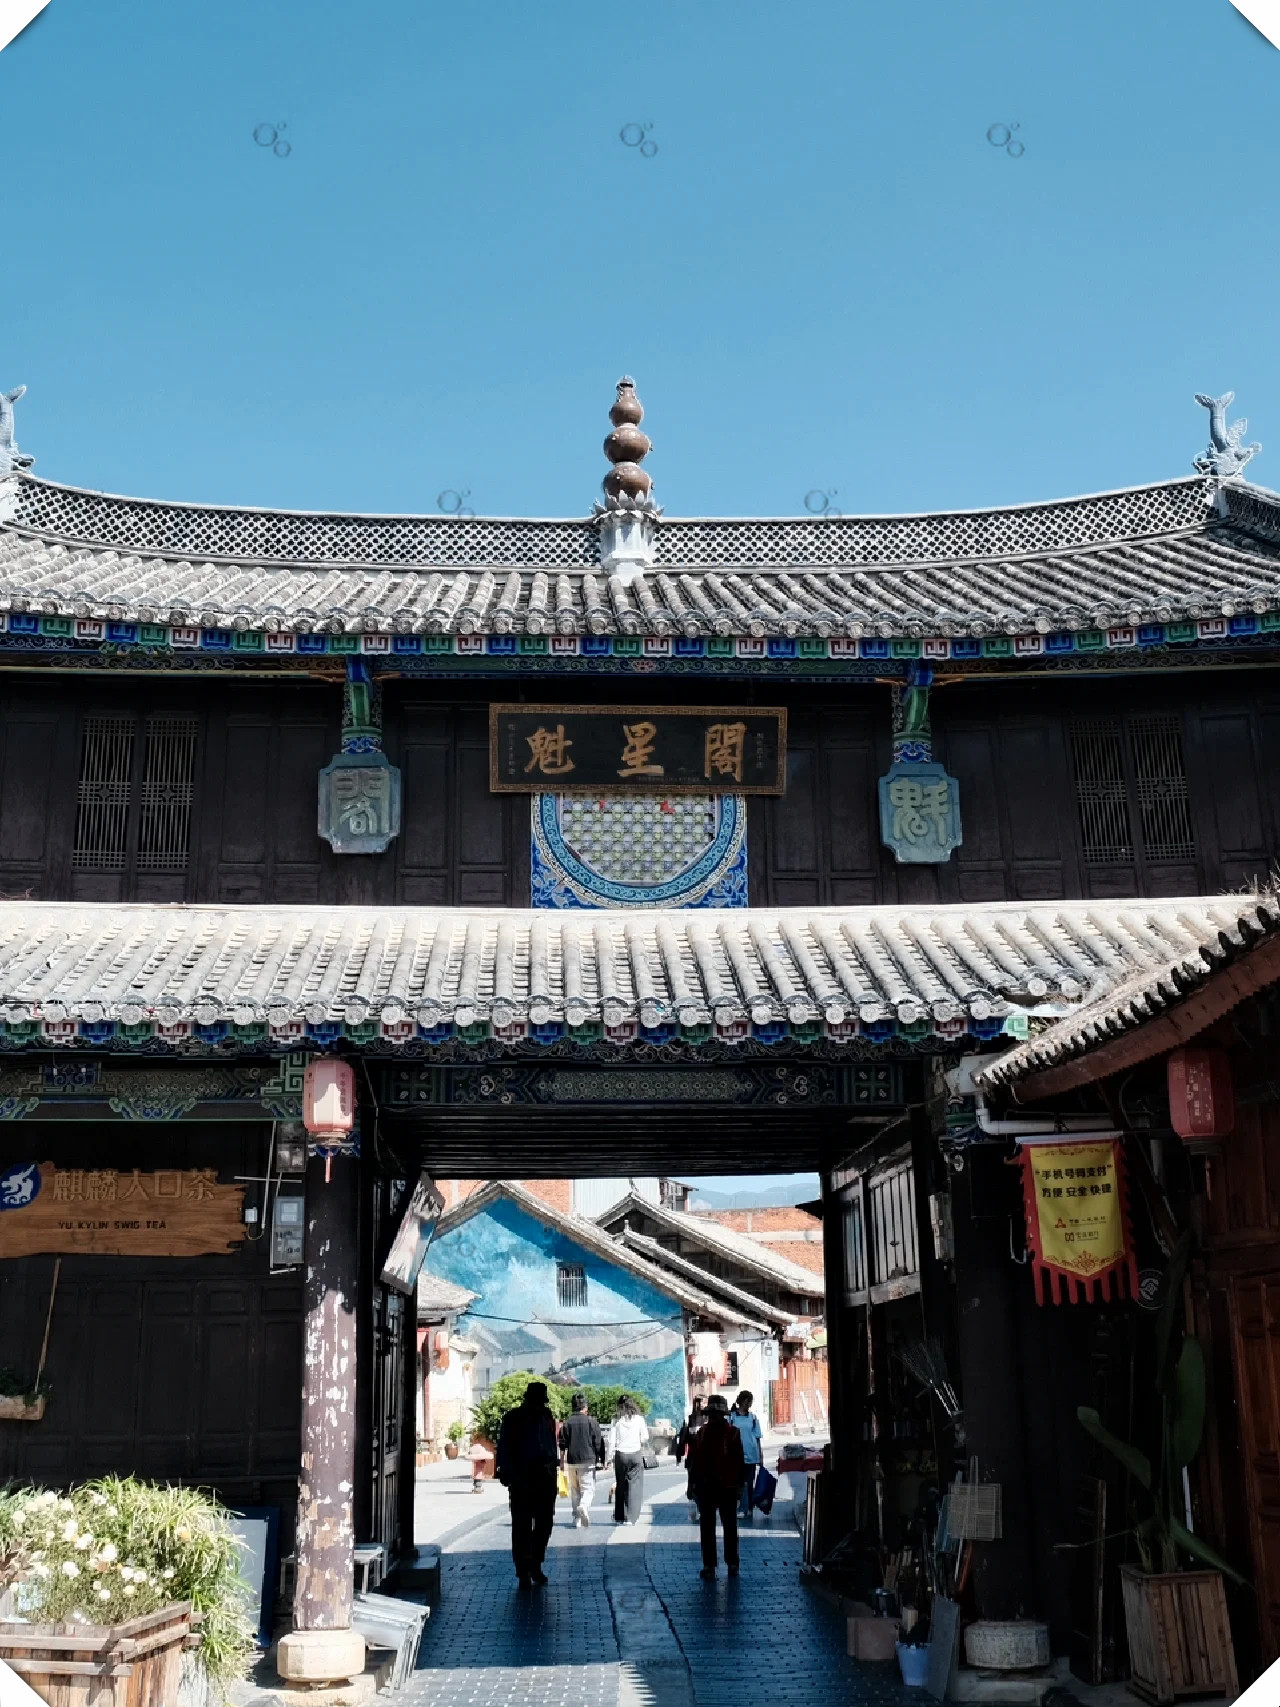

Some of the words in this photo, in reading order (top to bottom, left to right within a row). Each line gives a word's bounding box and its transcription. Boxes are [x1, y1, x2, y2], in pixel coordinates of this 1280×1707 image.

[52, 1168, 217, 1201] 麒麟大口茶
[1042, 1187, 1063, 1198] 方便
[1066, 1186, 1087, 1197] 安全
[77, 1220, 108, 1230] KYLIN
[113, 1220, 140, 1230] SWIG
[145, 1220, 167, 1230] TEA
